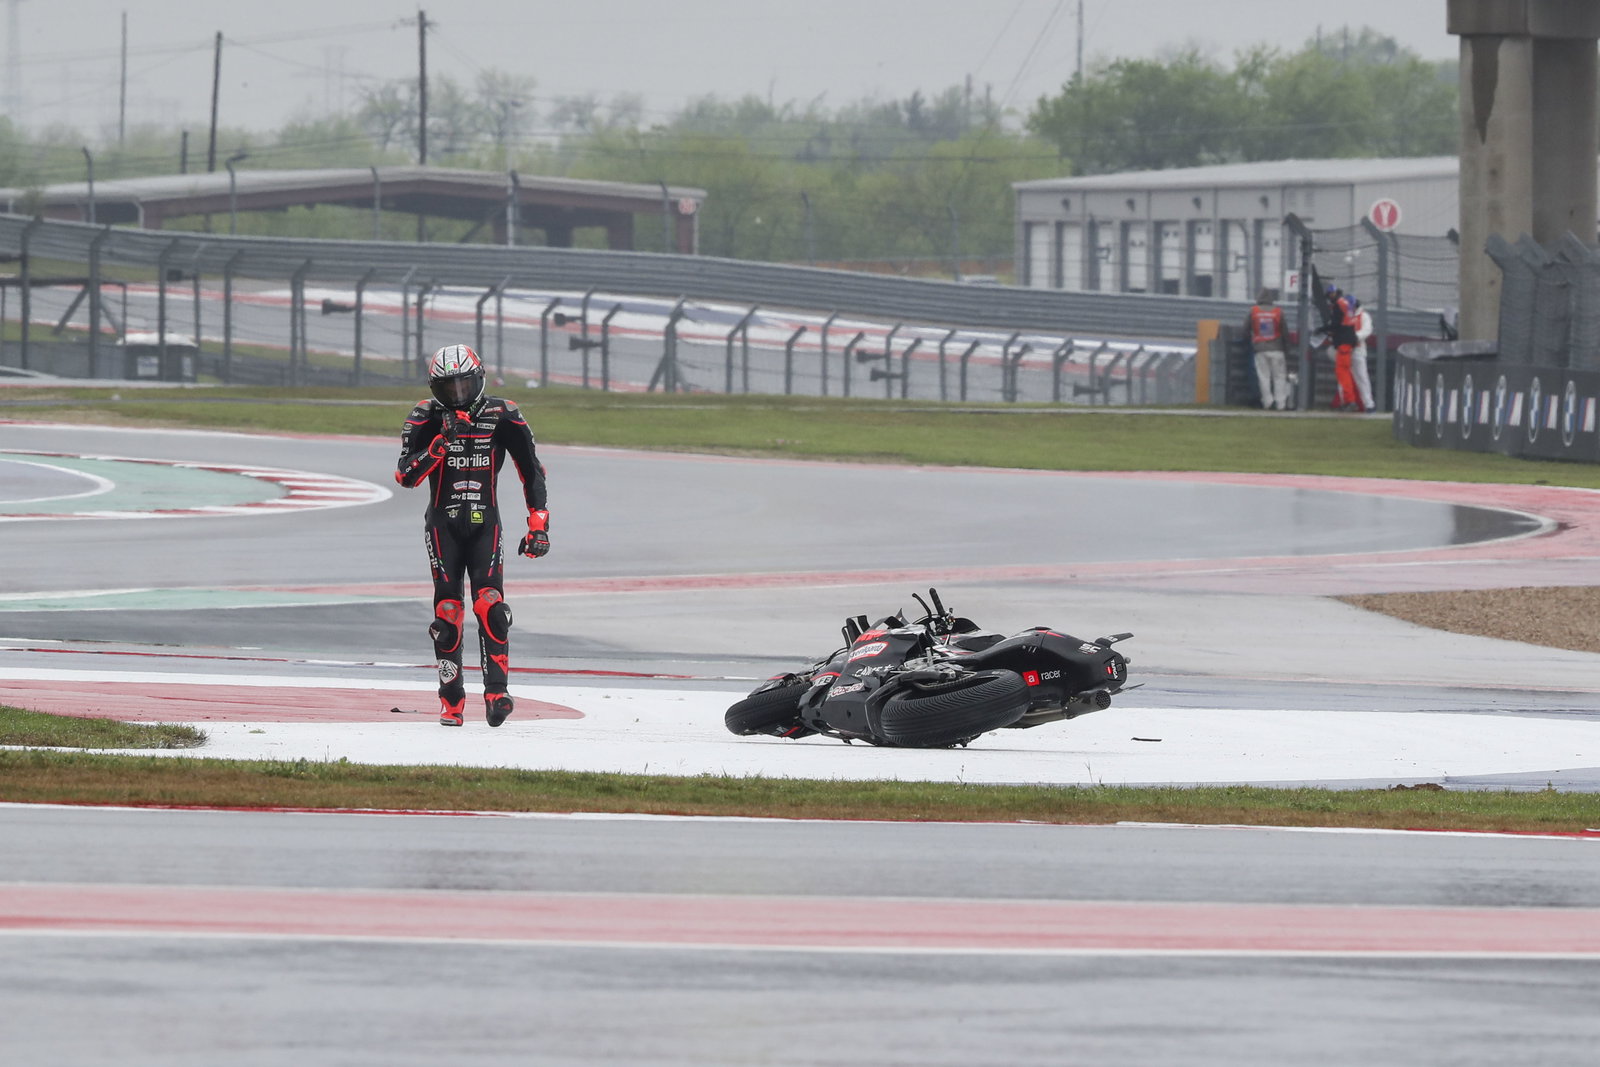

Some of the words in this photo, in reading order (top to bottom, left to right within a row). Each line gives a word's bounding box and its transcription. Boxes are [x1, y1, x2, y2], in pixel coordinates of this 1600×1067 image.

[447, 453, 490, 469] aprilia
[425, 531, 439, 568] aprili
[1028, 675, 1035, 683] a
[1040, 669, 1061, 680] racer
